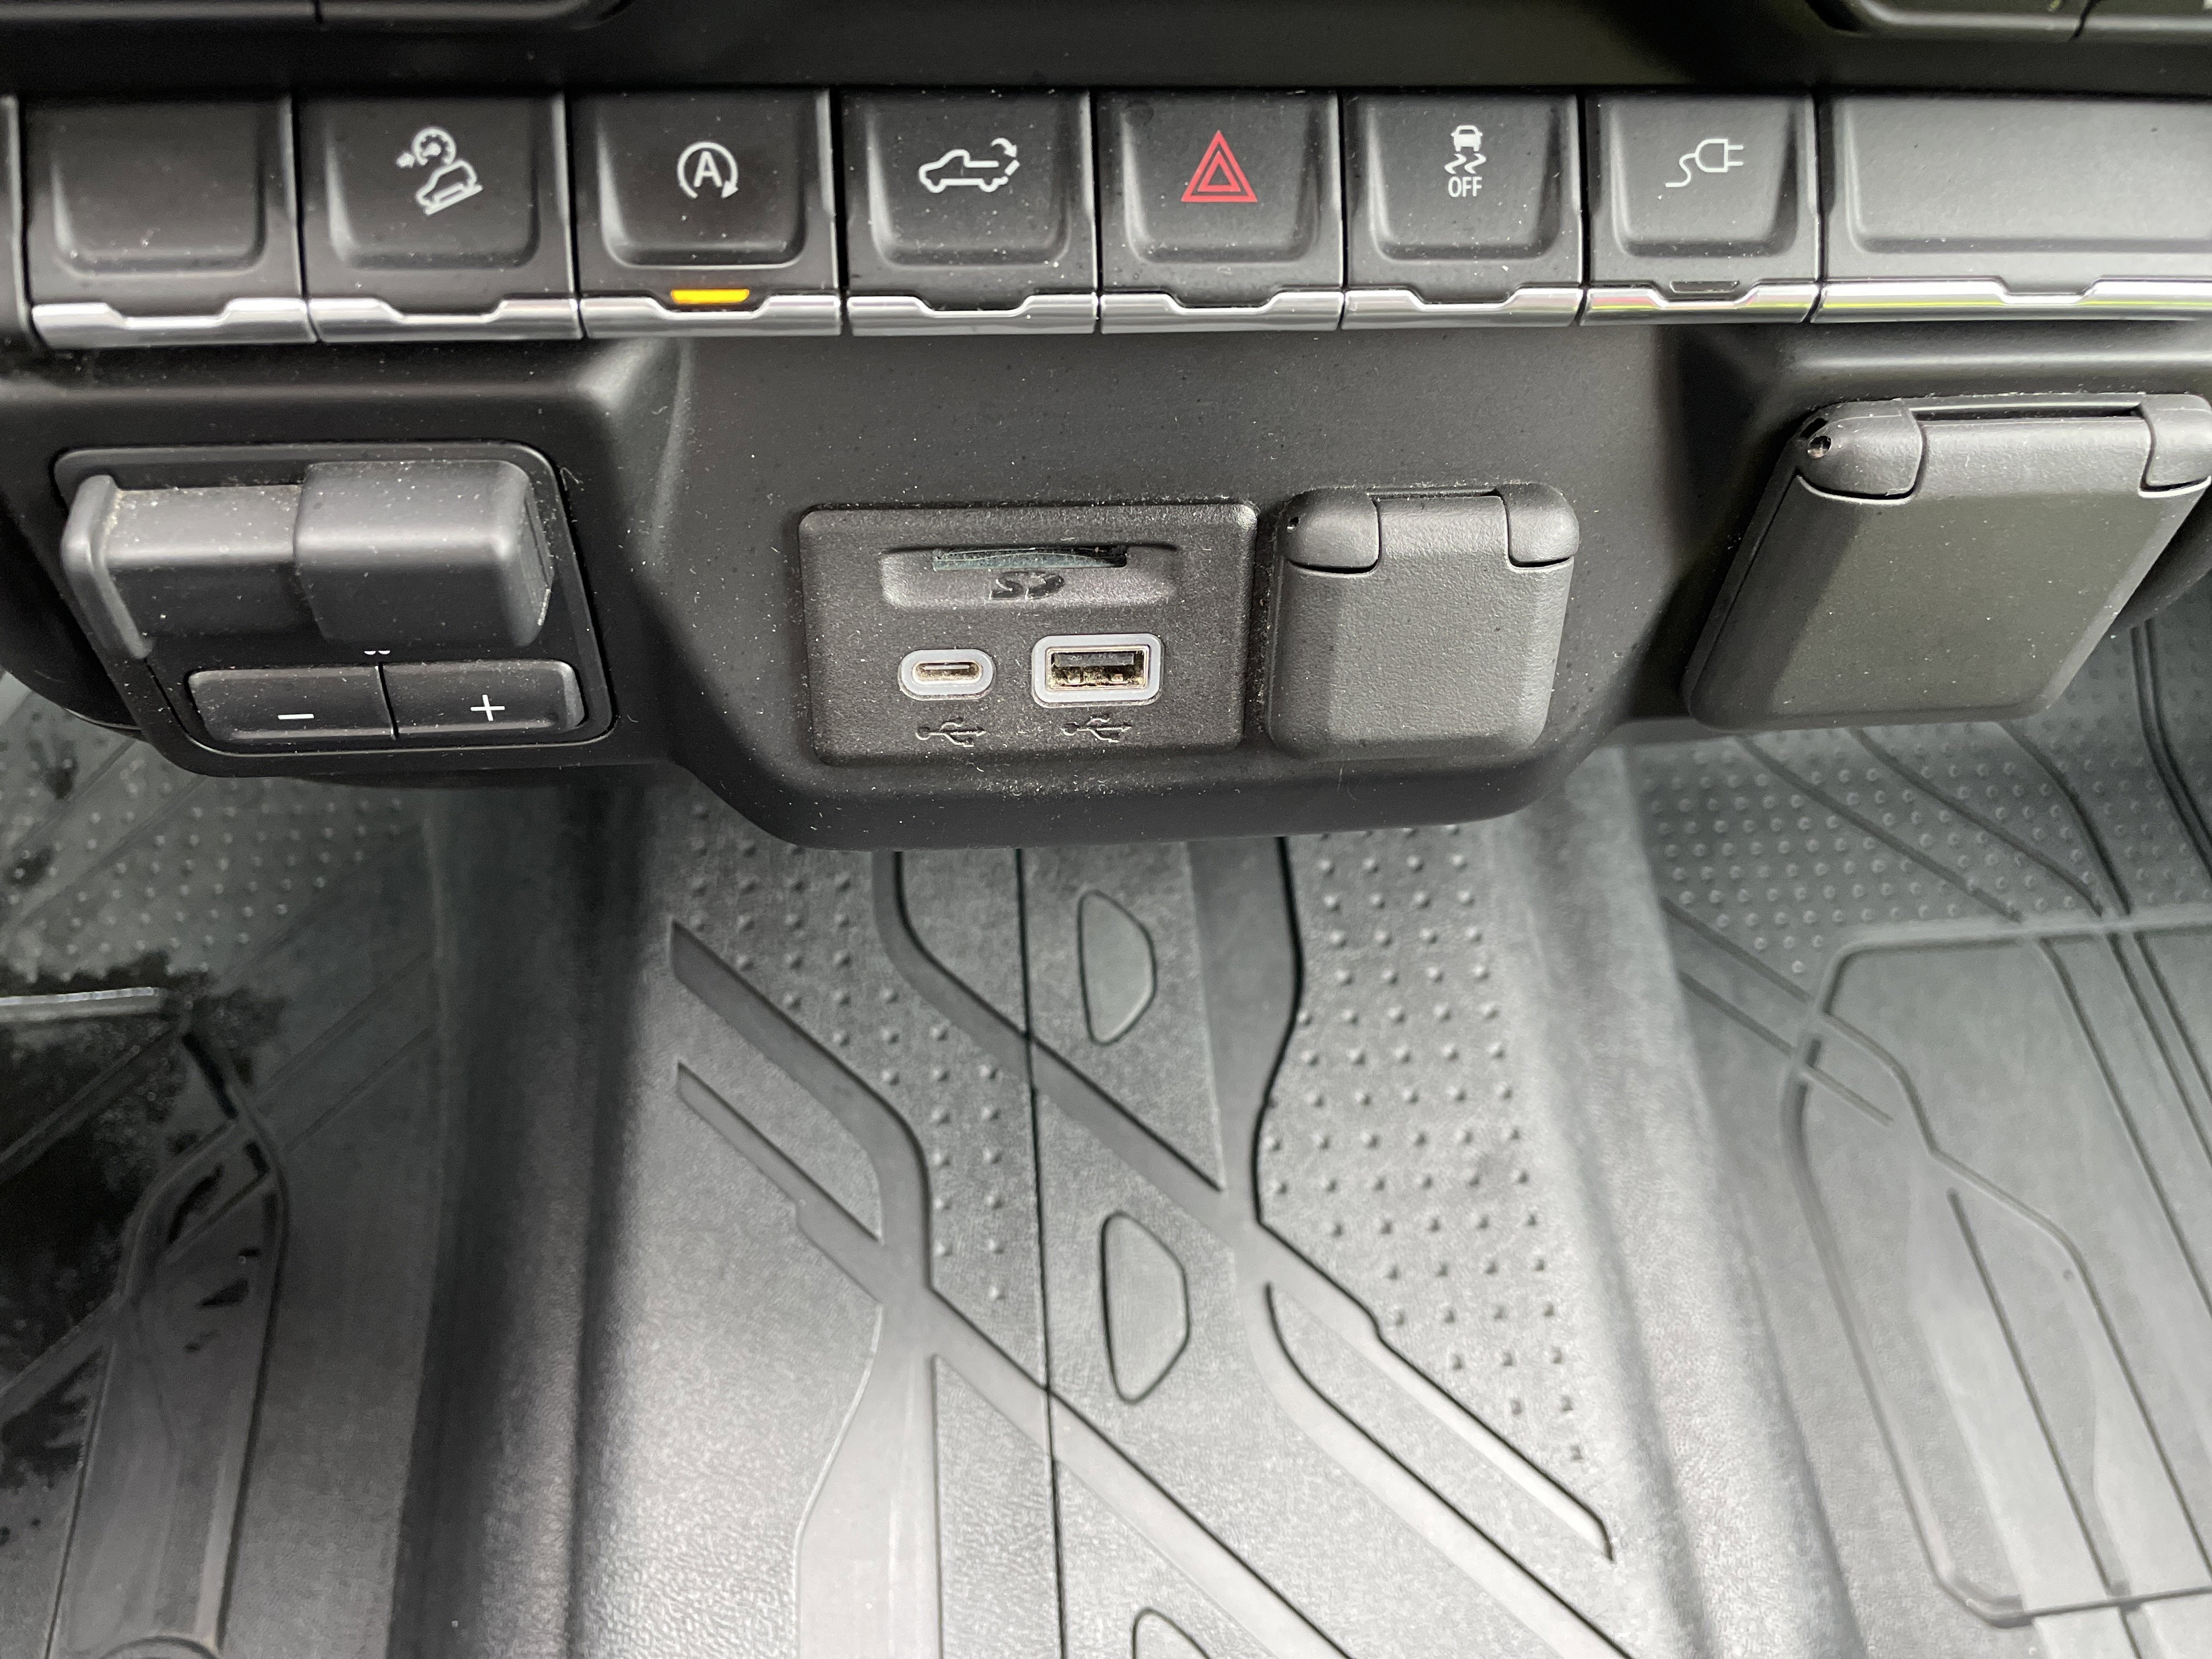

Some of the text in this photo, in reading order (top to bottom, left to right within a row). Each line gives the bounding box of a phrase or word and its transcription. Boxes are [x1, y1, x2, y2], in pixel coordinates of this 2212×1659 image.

[693, 151, 723, 188] A
[1448, 176, 1483, 198] OFF
[988, 571, 1065, 601] SD
